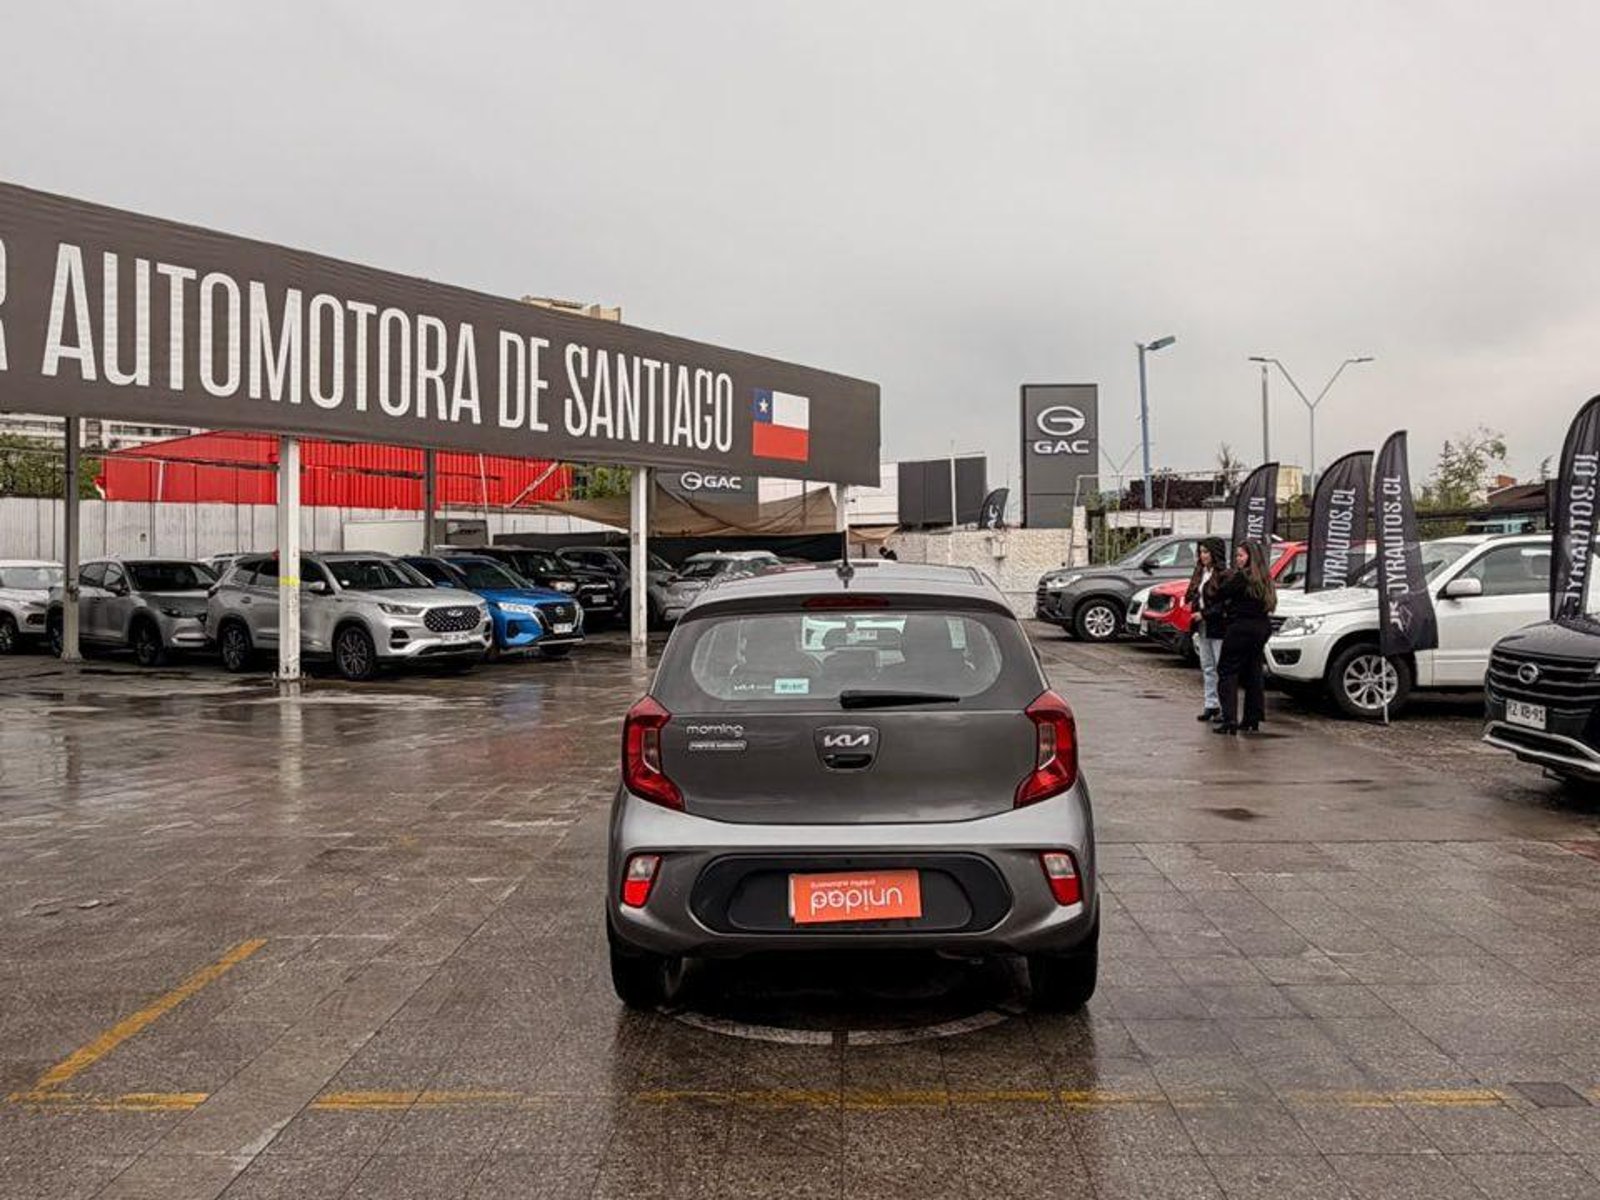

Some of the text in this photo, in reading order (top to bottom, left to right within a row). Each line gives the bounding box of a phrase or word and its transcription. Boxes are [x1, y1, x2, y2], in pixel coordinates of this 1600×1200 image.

[42, 242, 482, 425] AUTOMOTORA
[500, 331, 549, 432] DE
[565, 342, 733, 453] SANTIAGO
[1034, 439, 1090, 454] GAC
[704, 475, 742, 490] GAC
[1382, 474, 1409, 596] JYRAUTOS.CL
[686, 723, 744, 738] morning
[824, 734, 871, 748] KIA
[810, 886, 903, 917] unidad
